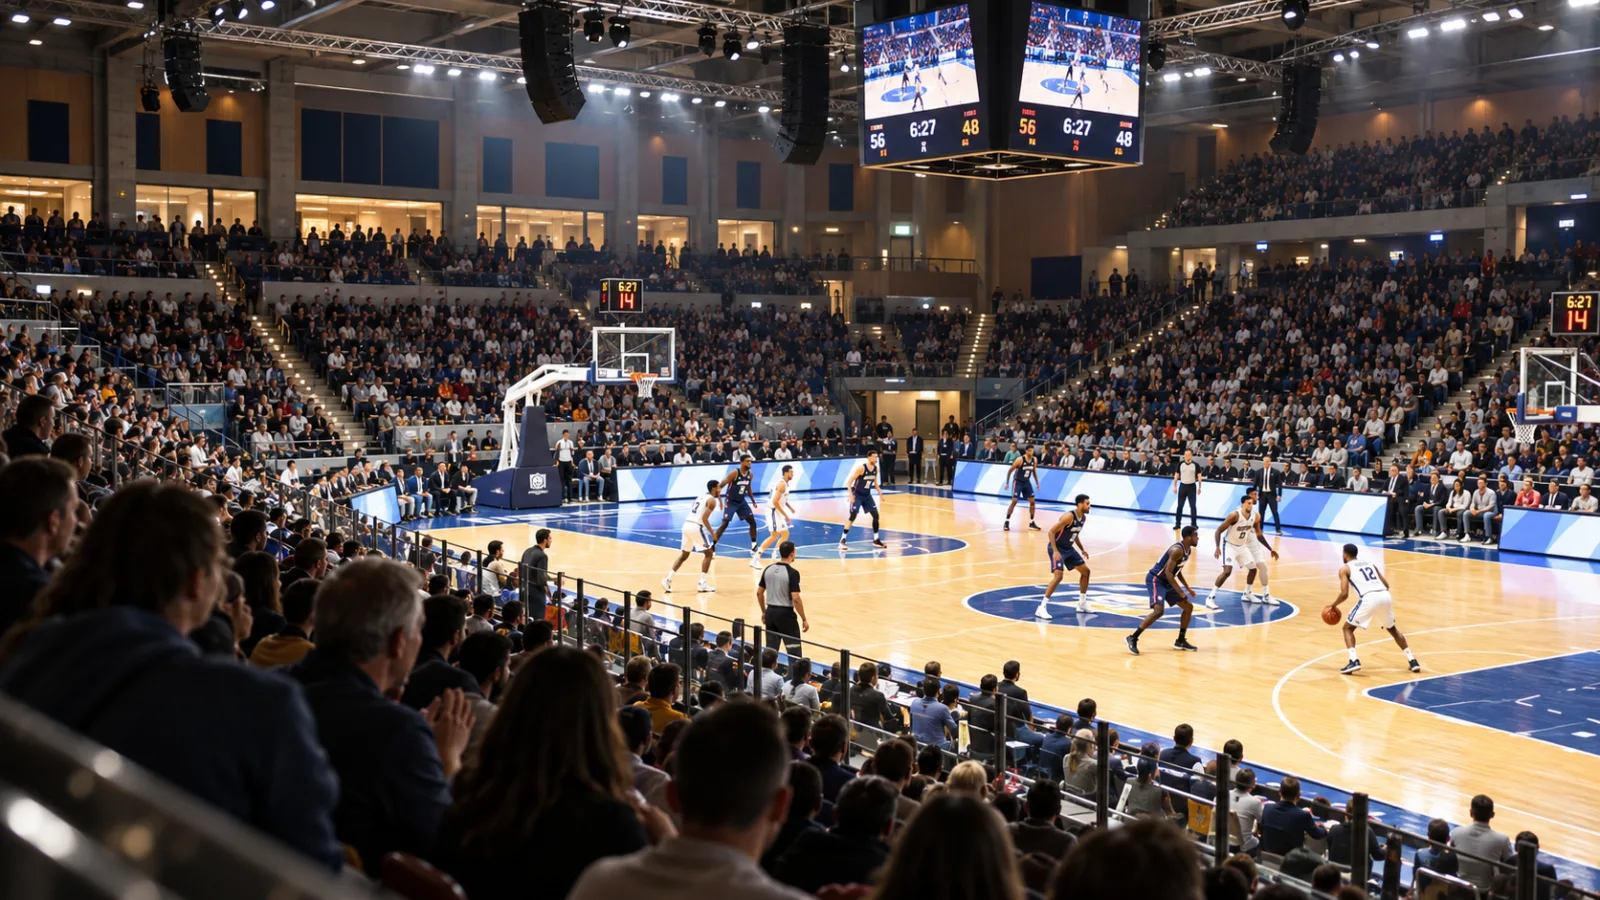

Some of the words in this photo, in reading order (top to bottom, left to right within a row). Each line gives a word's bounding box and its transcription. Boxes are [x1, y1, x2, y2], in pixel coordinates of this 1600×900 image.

[909, 119, 936, 138] 6:27
[962, 118, 980, 136] 48
[1019, 117, 1036, 135] 56
[1063, 117, 1092, 136] 6:27
[870, 132, 886, 149] 56
[1116, 130, 1133, 147] 48
[618, 281, 637, 292] 6:27
[619, 293, 634, 309] 14
[1567, 295, 1592, 309] 6:27
[1567, 310, 1588, 331] 14
[1359, 566, 1377, 582] 12
